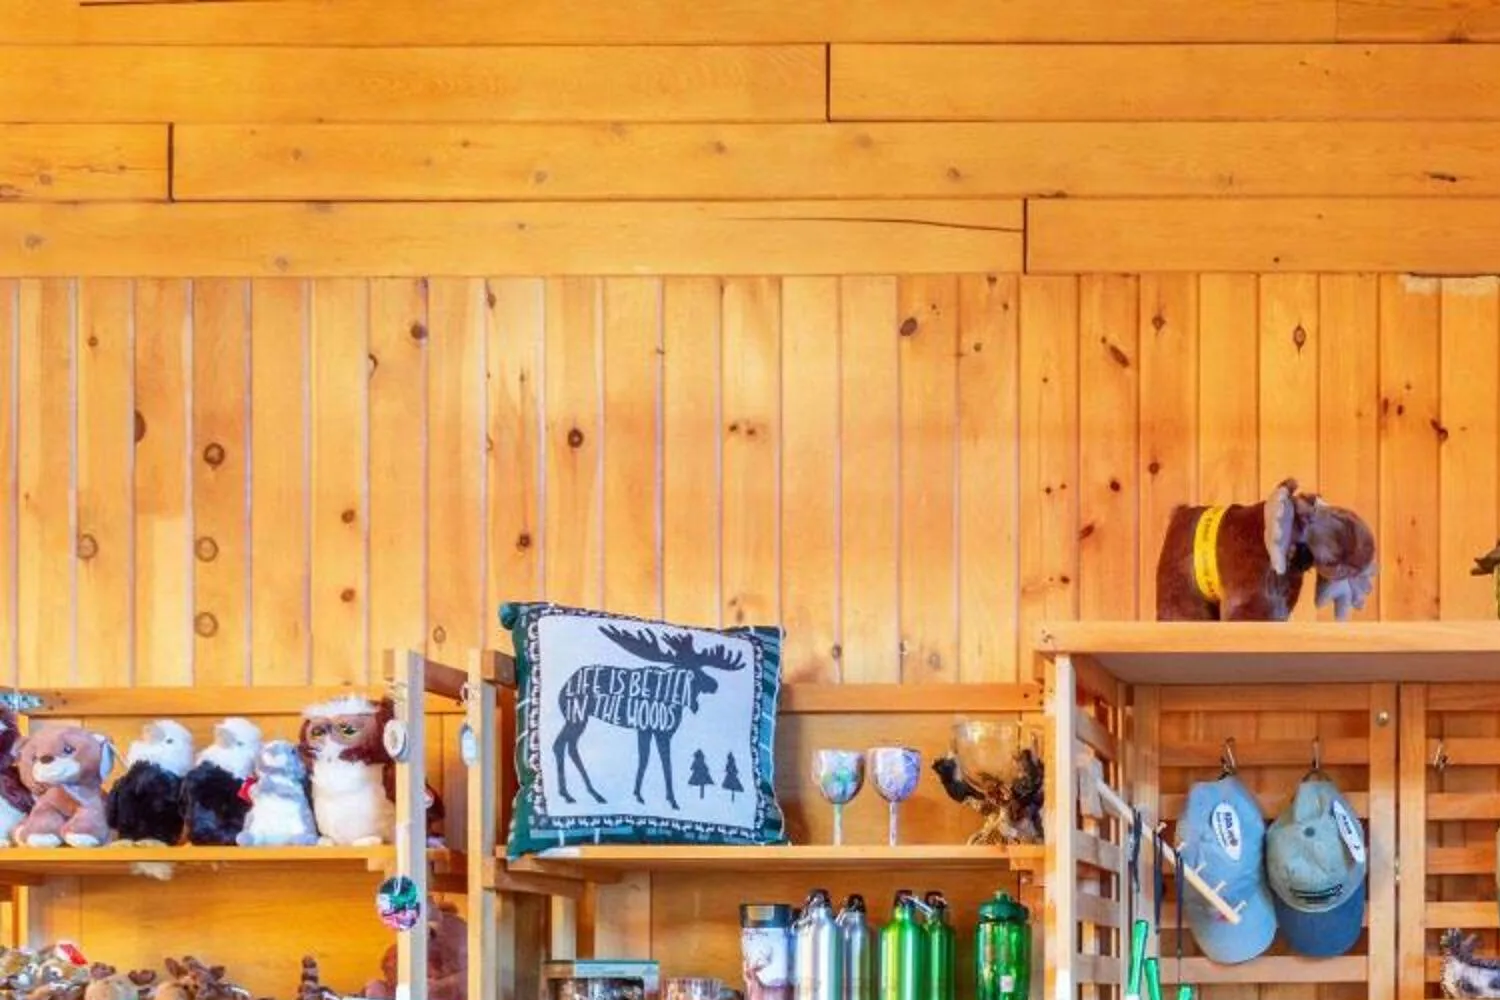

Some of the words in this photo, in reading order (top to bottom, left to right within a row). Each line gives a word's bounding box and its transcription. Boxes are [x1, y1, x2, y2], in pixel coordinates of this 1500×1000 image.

[566, 667, 602, 696] LIFE
[610, 669, 625, 695] IS
[629, 668, 695, 706] BETTER
[567, 695, 588, 723] IN
[594, 694, 623, 724] THE
[627, 697, 676, 731] WOODS
